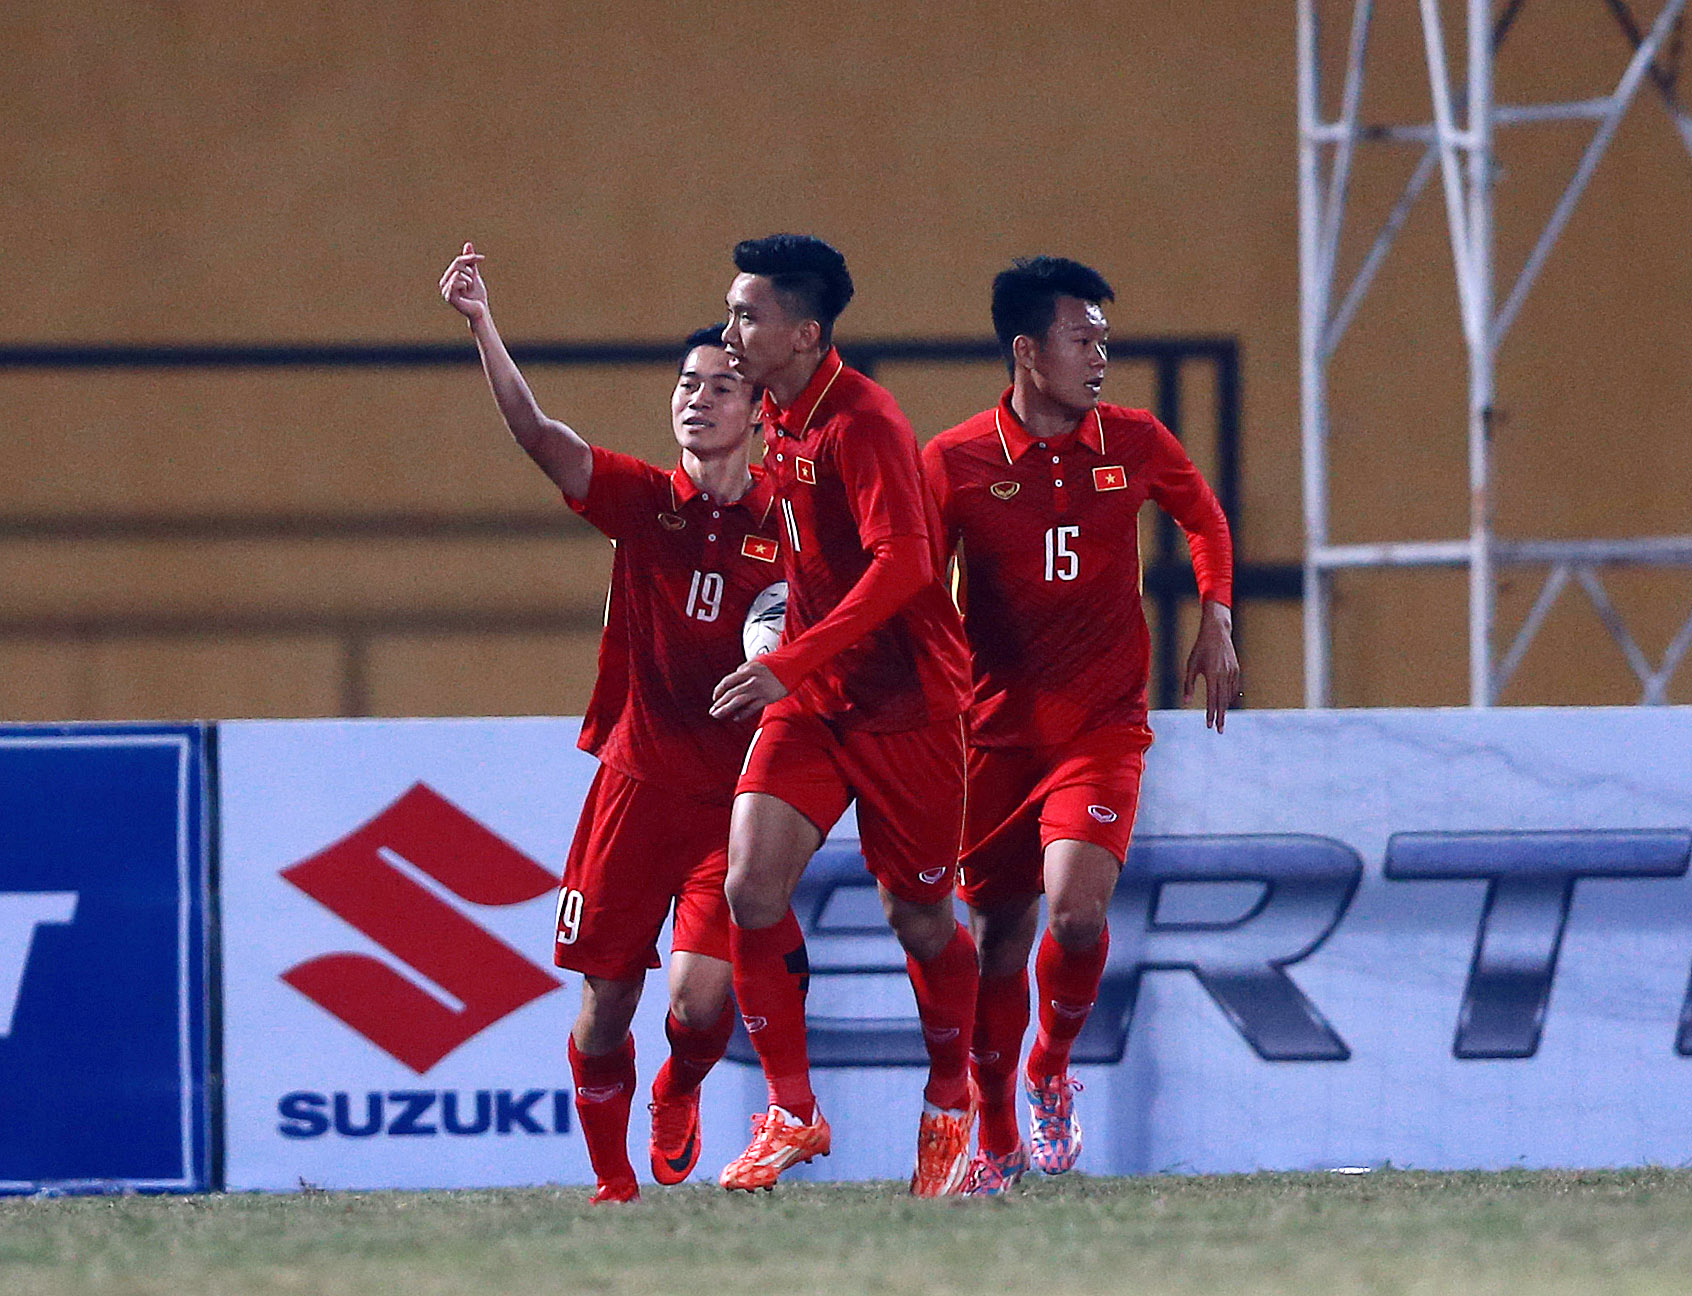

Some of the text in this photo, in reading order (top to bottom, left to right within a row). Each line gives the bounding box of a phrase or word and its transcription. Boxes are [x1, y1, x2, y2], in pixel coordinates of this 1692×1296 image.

[781, 498, 801, 552] 11
[1044, 525, 1080, 582] 15
[685, 570, 724, 622] 19
[555, 886, 584, 945] 19
[277, 1089, 572, 1139] SUZUKI
